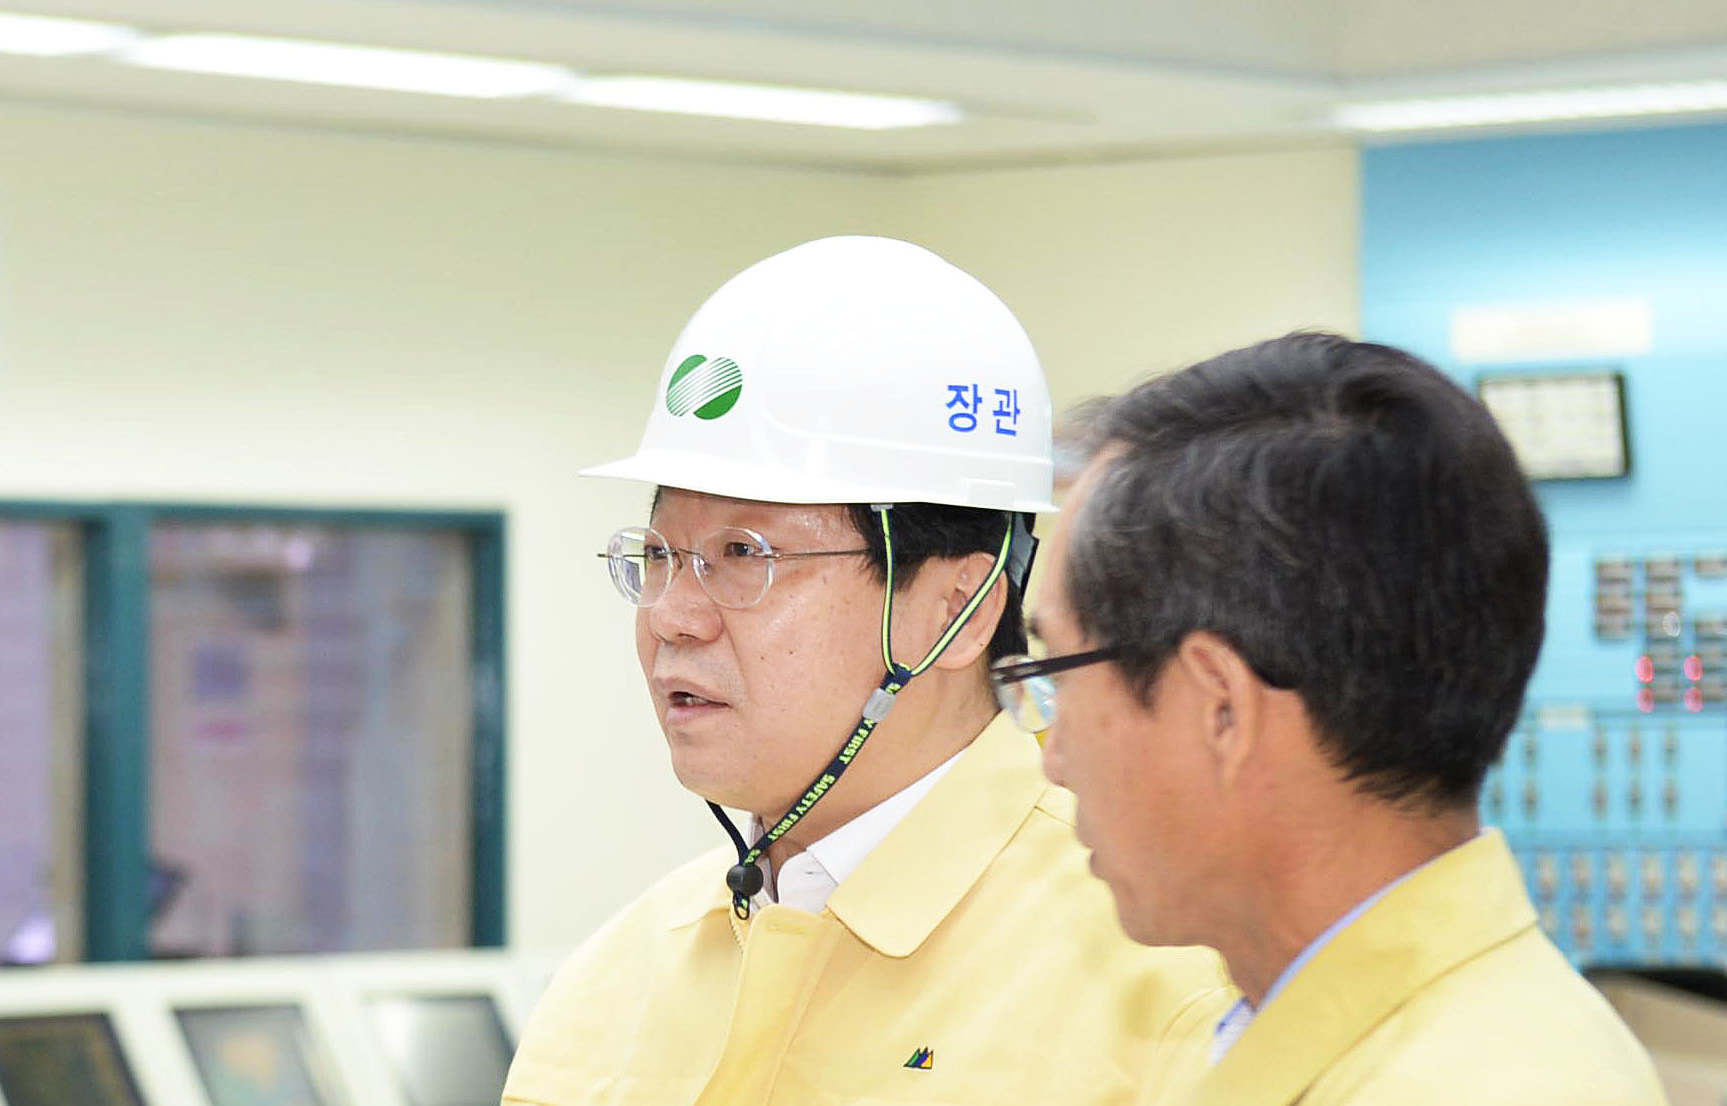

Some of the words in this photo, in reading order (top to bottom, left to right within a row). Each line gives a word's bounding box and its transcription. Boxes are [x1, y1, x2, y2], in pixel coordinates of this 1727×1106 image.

[945, 383, 1021, 437] 장관
[839, 729, 869, 764] FIRST
[796, 774, 836, 814] SAFETY
[767, 813, 799, 840] FIRST
